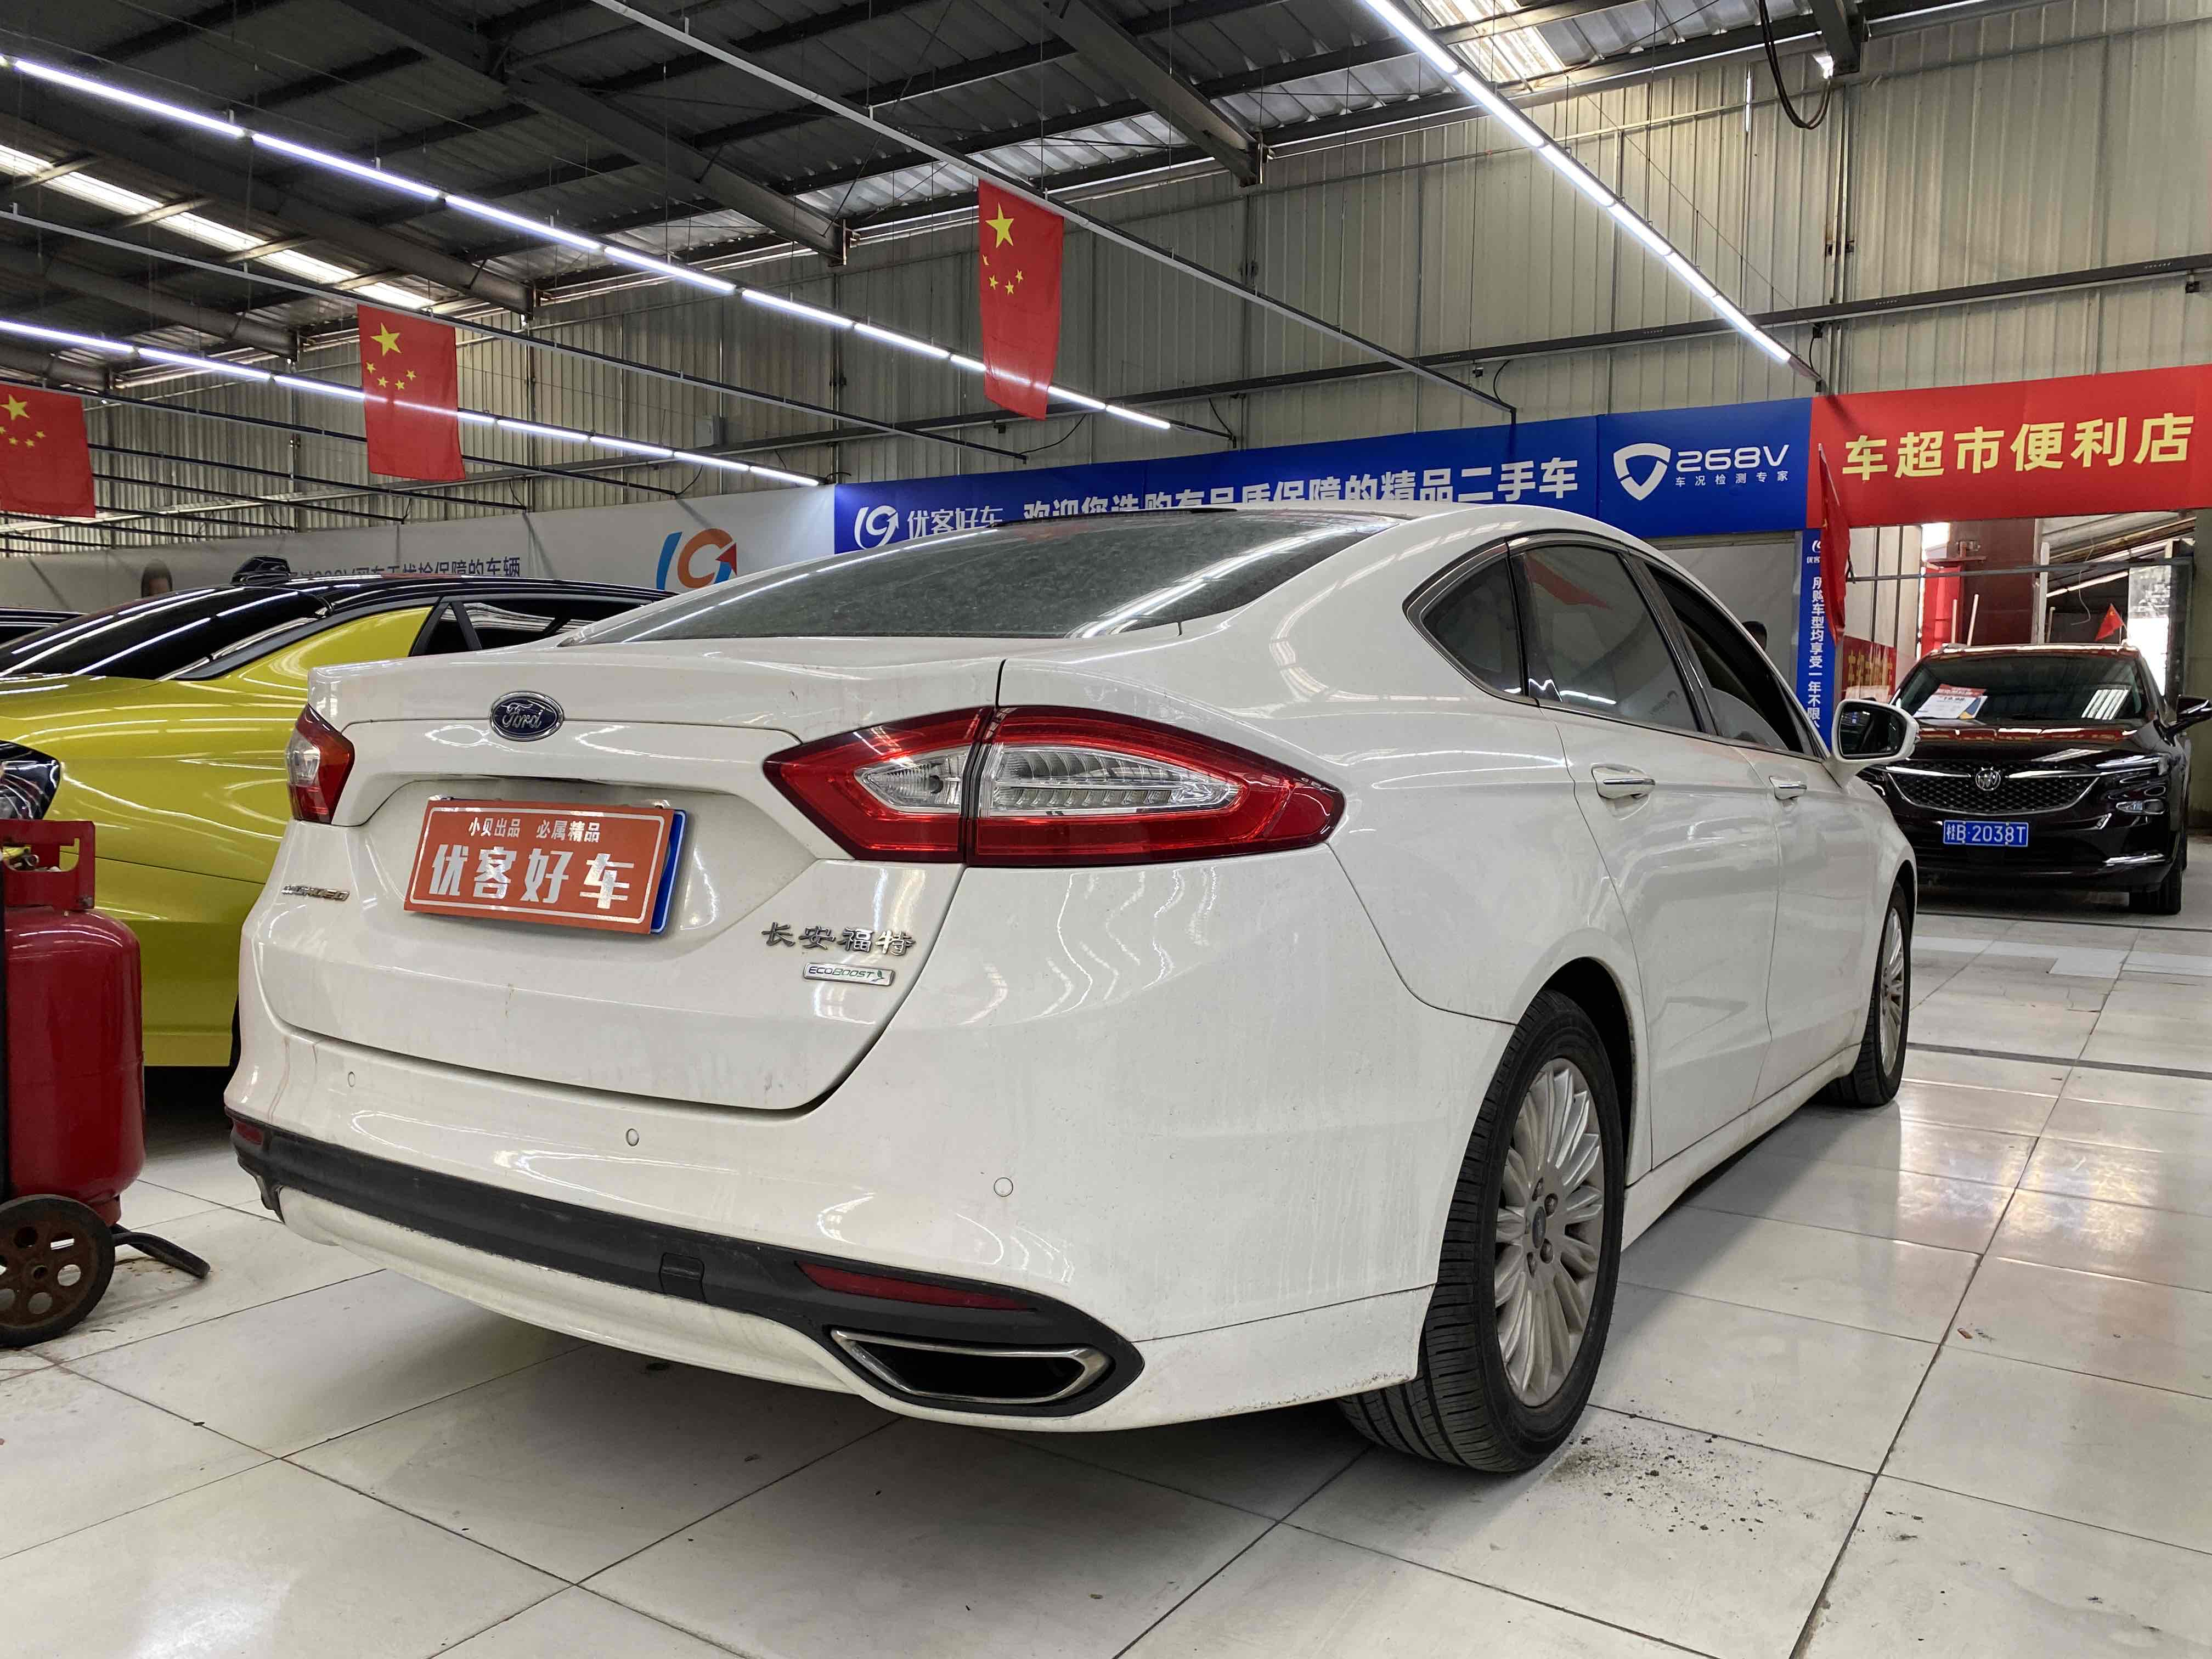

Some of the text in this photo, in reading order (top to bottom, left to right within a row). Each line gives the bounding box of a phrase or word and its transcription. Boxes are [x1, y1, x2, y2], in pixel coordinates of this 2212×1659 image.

[1676, 444, 1790, 472] 268V
[1842, 413, 2194, 481] 车超市便利店
[1675, 471, 1788, 488] 车况检测专家
[500, 702, 544, 729] Ford
[469, 816, 600, 843] 小贝出品 必属精品
[428, 844, 635, 909] 优客好车
[761, 922, 916, 956] 长安福特
